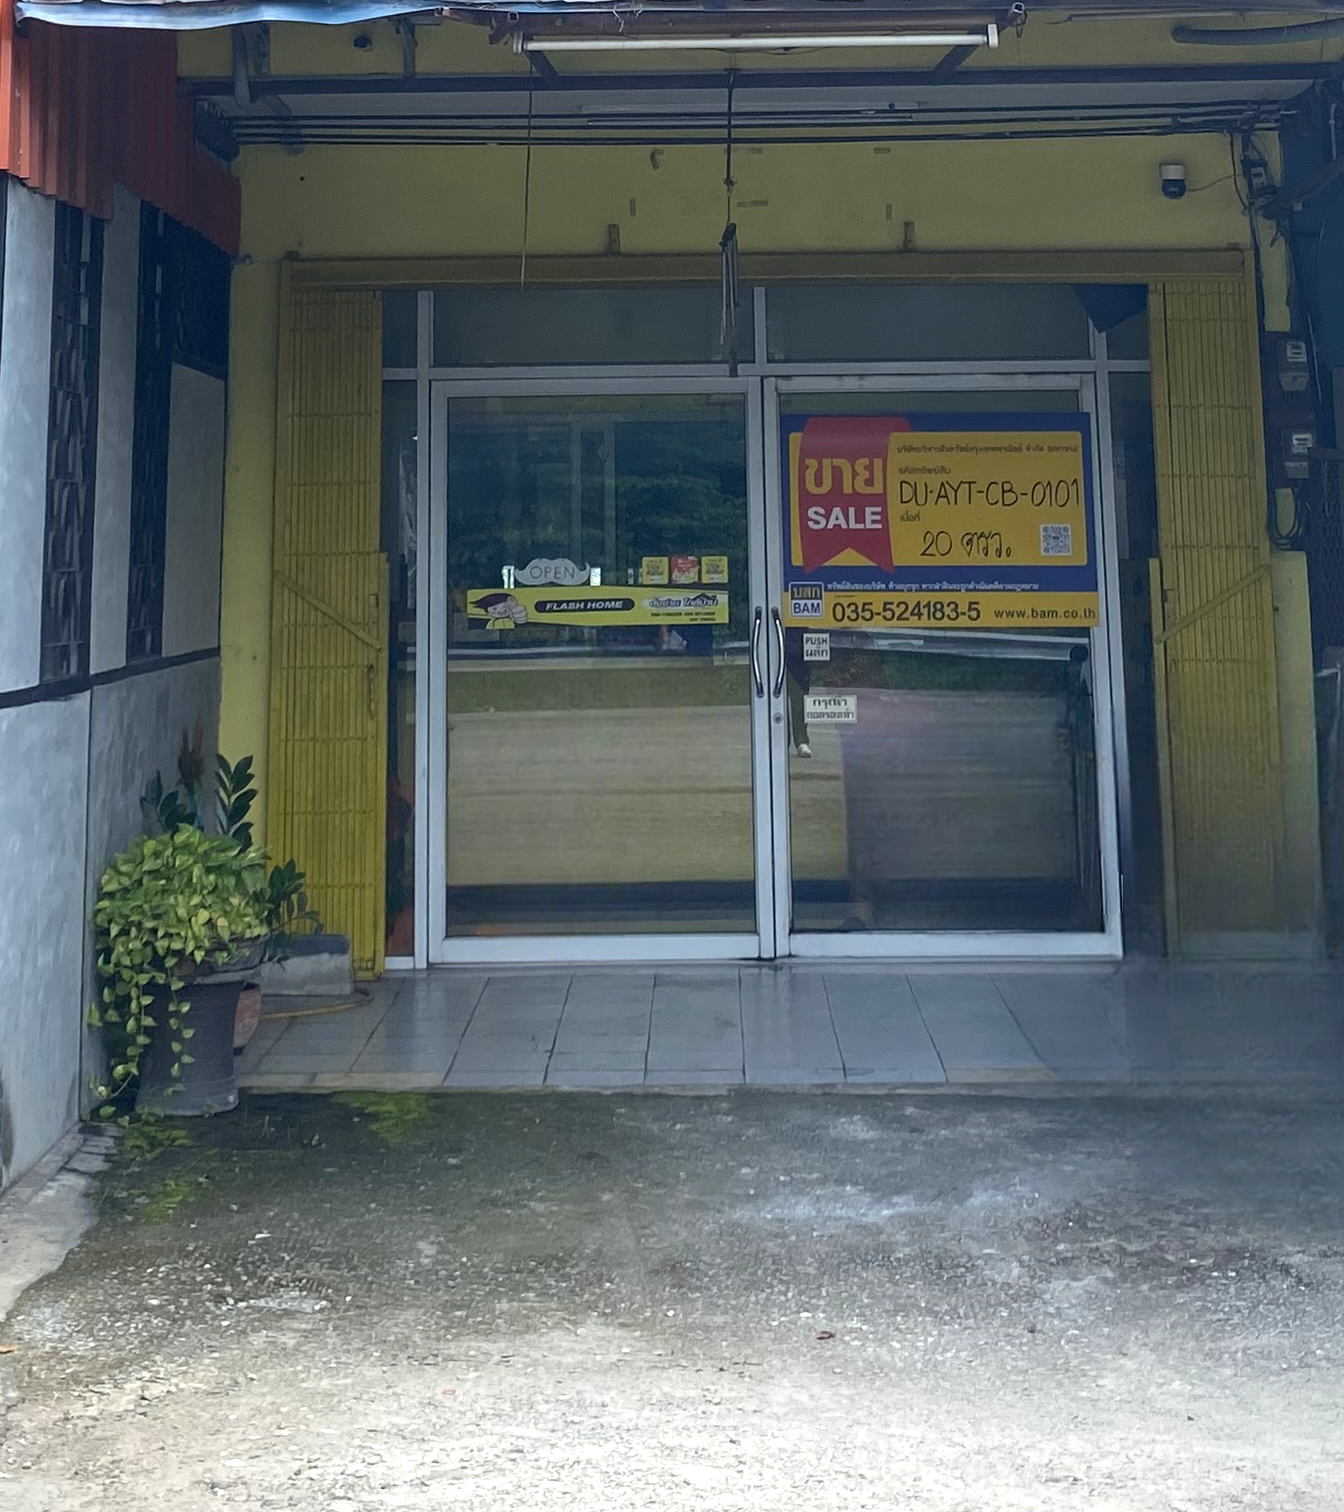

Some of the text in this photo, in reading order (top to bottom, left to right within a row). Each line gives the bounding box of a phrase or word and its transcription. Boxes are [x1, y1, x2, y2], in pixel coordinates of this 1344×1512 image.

[805, 457, 884, 495] ขาย
[807, 506, 883, 530] SALE
[919, 530, 953, 558] 20
[529, 565, 576, 581] OPEN
[545, 600, 623, 611] FLASH HOME
[793, 601, 821, 614] BAM
[832, 600, 1096, 622] 035-524183-5 www.bam.co.th
[805, 636, 828, 645] PUSH
